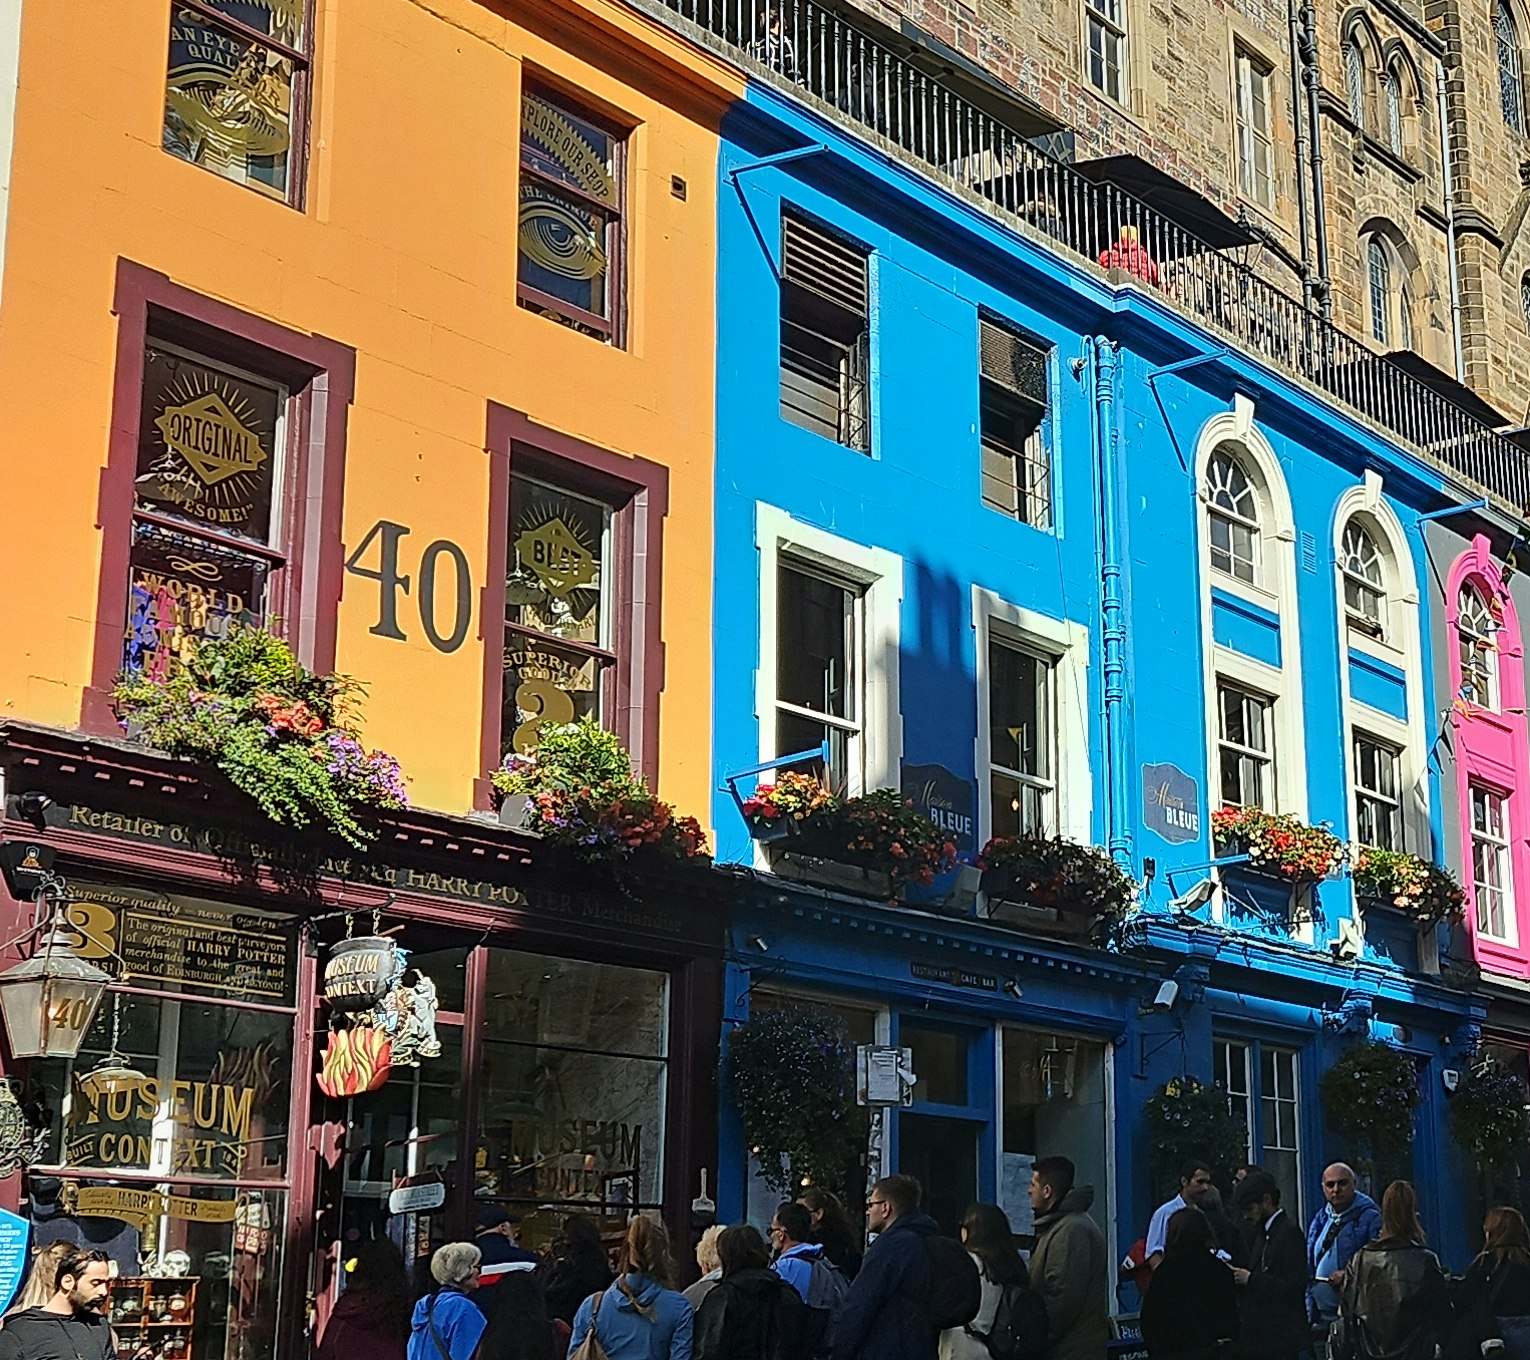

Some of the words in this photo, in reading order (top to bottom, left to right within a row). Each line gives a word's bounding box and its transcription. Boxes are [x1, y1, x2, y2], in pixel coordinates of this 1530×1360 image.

[171, 26, 197, 42] AN
[202, 30, 241, 57] EYE
[188, 44, 236, 70] QUAL
[520, 102, 563, 145] XPLORE
[561, 137, 584, 168] OUR
[582, 162, 609, 199] SHOP
[170, 413, 254, 464] ORIGINAL
[141, 571, 244, 614] WORLD
[344, 520, 472, 654] 40
[502, 651, 593, 691] SUPERIOR
[930, 806, 973, 836] BLEUE
[1165, 806, 1199, 832] BLEUE
[69, 803, 164, 842] Retailer
[407, 869, 483, 899] HARRY
[64, 884, 128, 905] Superior
[130, 897, 181, 915] quality
[127, 918, 149, 932] The
[150, 923, 195, 939] original
[195, 928, 214, 941] and
[216, 931, 237, 945] best
[125, 947, 192, 964] merchandise
[196, 956, 208, 967] to
[212, 957, 230, 970] the
[234, 962, 263, 977] great
[266, 967, 285, 979] and
[126, 933, 137, 943] of
[142, 934, 182, 949] official
[187, 940, 232, 957] HARRY
[237, 946, 287, 966] POTTER
[125, 960, 149, 974] good
[152, 963, 164, 974] of
[166, 964, 223, 983] EDINBURGH
[325, 978, 377, 999] ONTEXT
[52, 997, 88, 1031] 40
[66, 1141, 94, 1161] BUILT
[100, 1131, 216, 1169] CONTEXT
